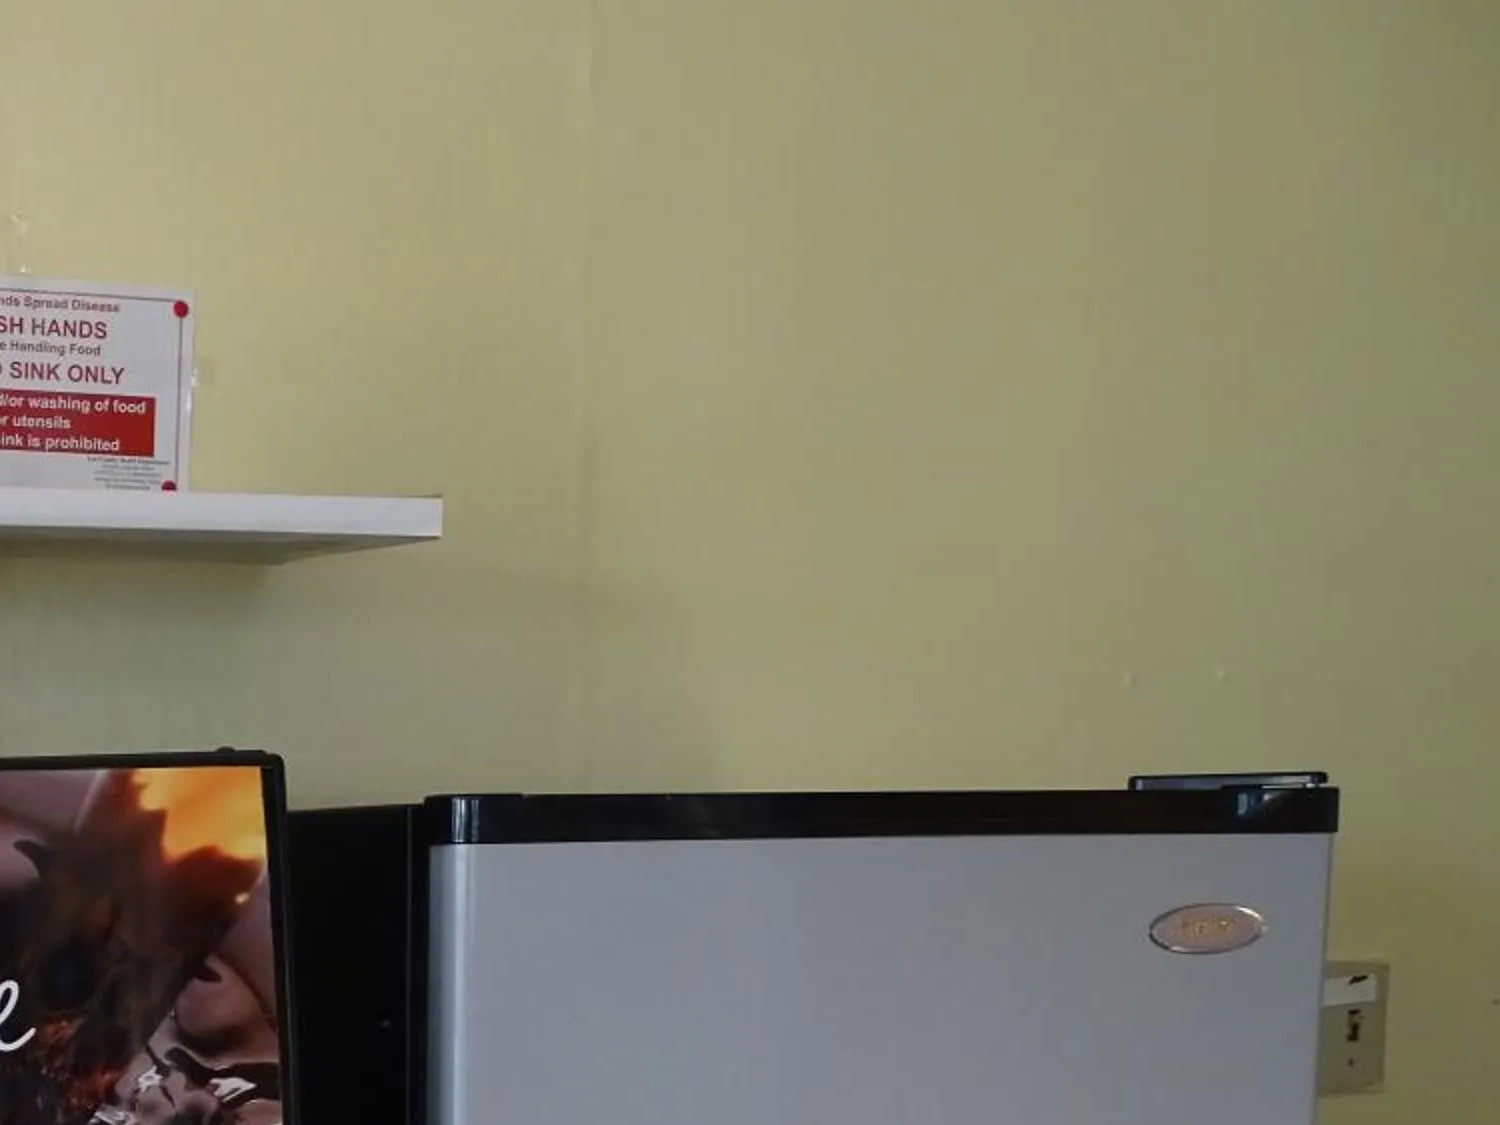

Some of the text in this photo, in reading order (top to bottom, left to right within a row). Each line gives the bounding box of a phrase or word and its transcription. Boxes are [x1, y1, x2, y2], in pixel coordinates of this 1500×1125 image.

[23, 296, 69, 313] Spread
[71, 299, 120, 313] Disease
[31, 317, 108, 339] HANDS
[10, 340, 66, 357] Handling
[69, 343, 101, 356] Food
[10, 360, 60, 382] SINK
[68, 364, 125, 385] ONLY
[28, 394, 90, 414] washing
[95, 395, 110, 412] of
[113, 397, 146, 414] food
[13, 413, 71, 429] utensils
[27, 434, 41, 449] is
[45, 435, 120, 454] prohibited
